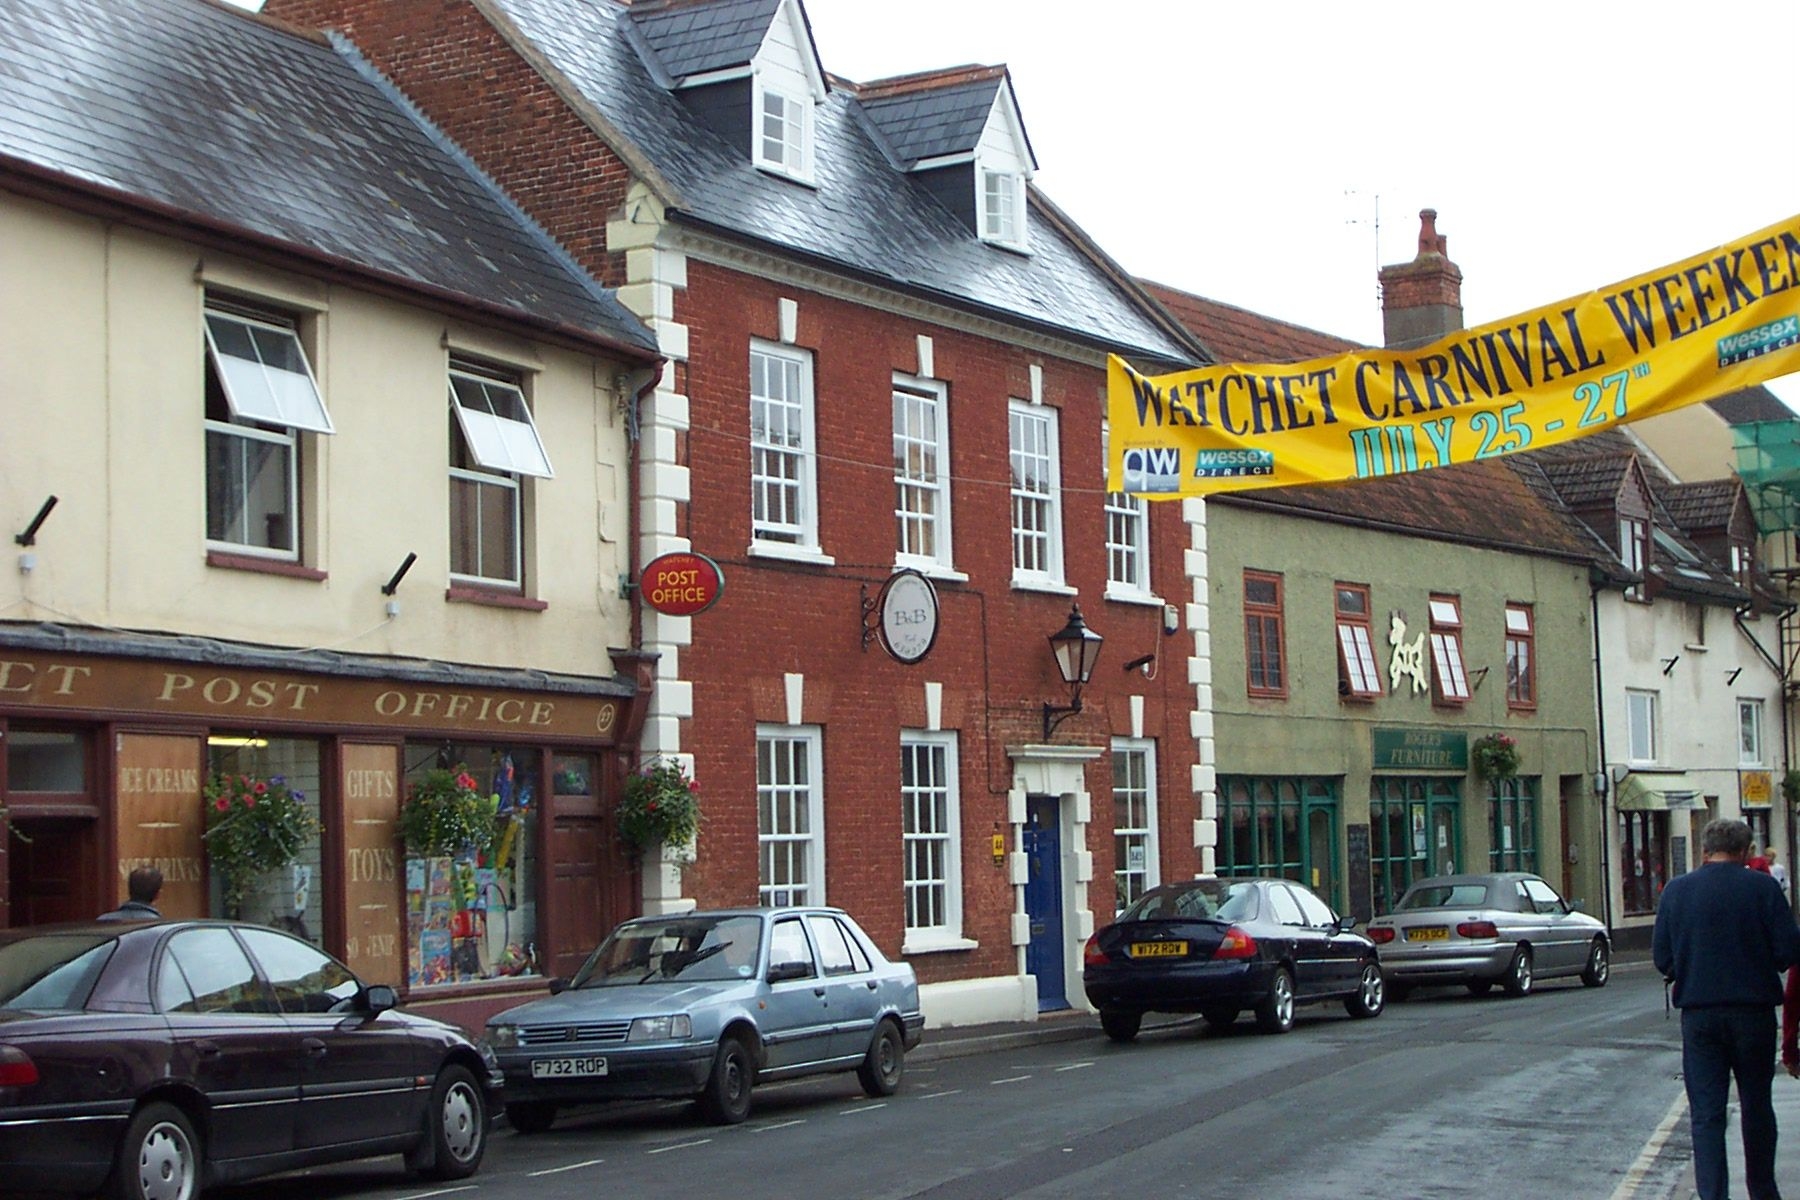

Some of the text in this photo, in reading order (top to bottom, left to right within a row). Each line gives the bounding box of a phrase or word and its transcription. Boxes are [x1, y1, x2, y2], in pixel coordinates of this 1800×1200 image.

[1719, 316, 1797, 354] wessex
[1720, 335, 1800, 367] DIRECT
[1124, 366, 1339, 436] WATCHET
[1355, 307, 1606, 421] CARNIVAL
[1349, 416, 1456, 479] JULY
[1469, 401, 1532, 460] 25
[1199, 450, 1271, 465] wessex
[1196, 466, 1272, 476] DIRECT
[658, 570, 699, 587] POST
[651, 587, 706, 603] OFFICE
[894, 608, 927, 626] B&B
[157, 672, 320, 710] POST
[374, 690, 555, 727] OFFICE
[1391, 748, 1453, 765] FURNITURE
[122, 768, 198, 793] ICE CREAMS
[347, 769, 394, 798] GIFTS
[349, 848, 395, 882] TOYS
[534, 1060, 573, 1075] F732
